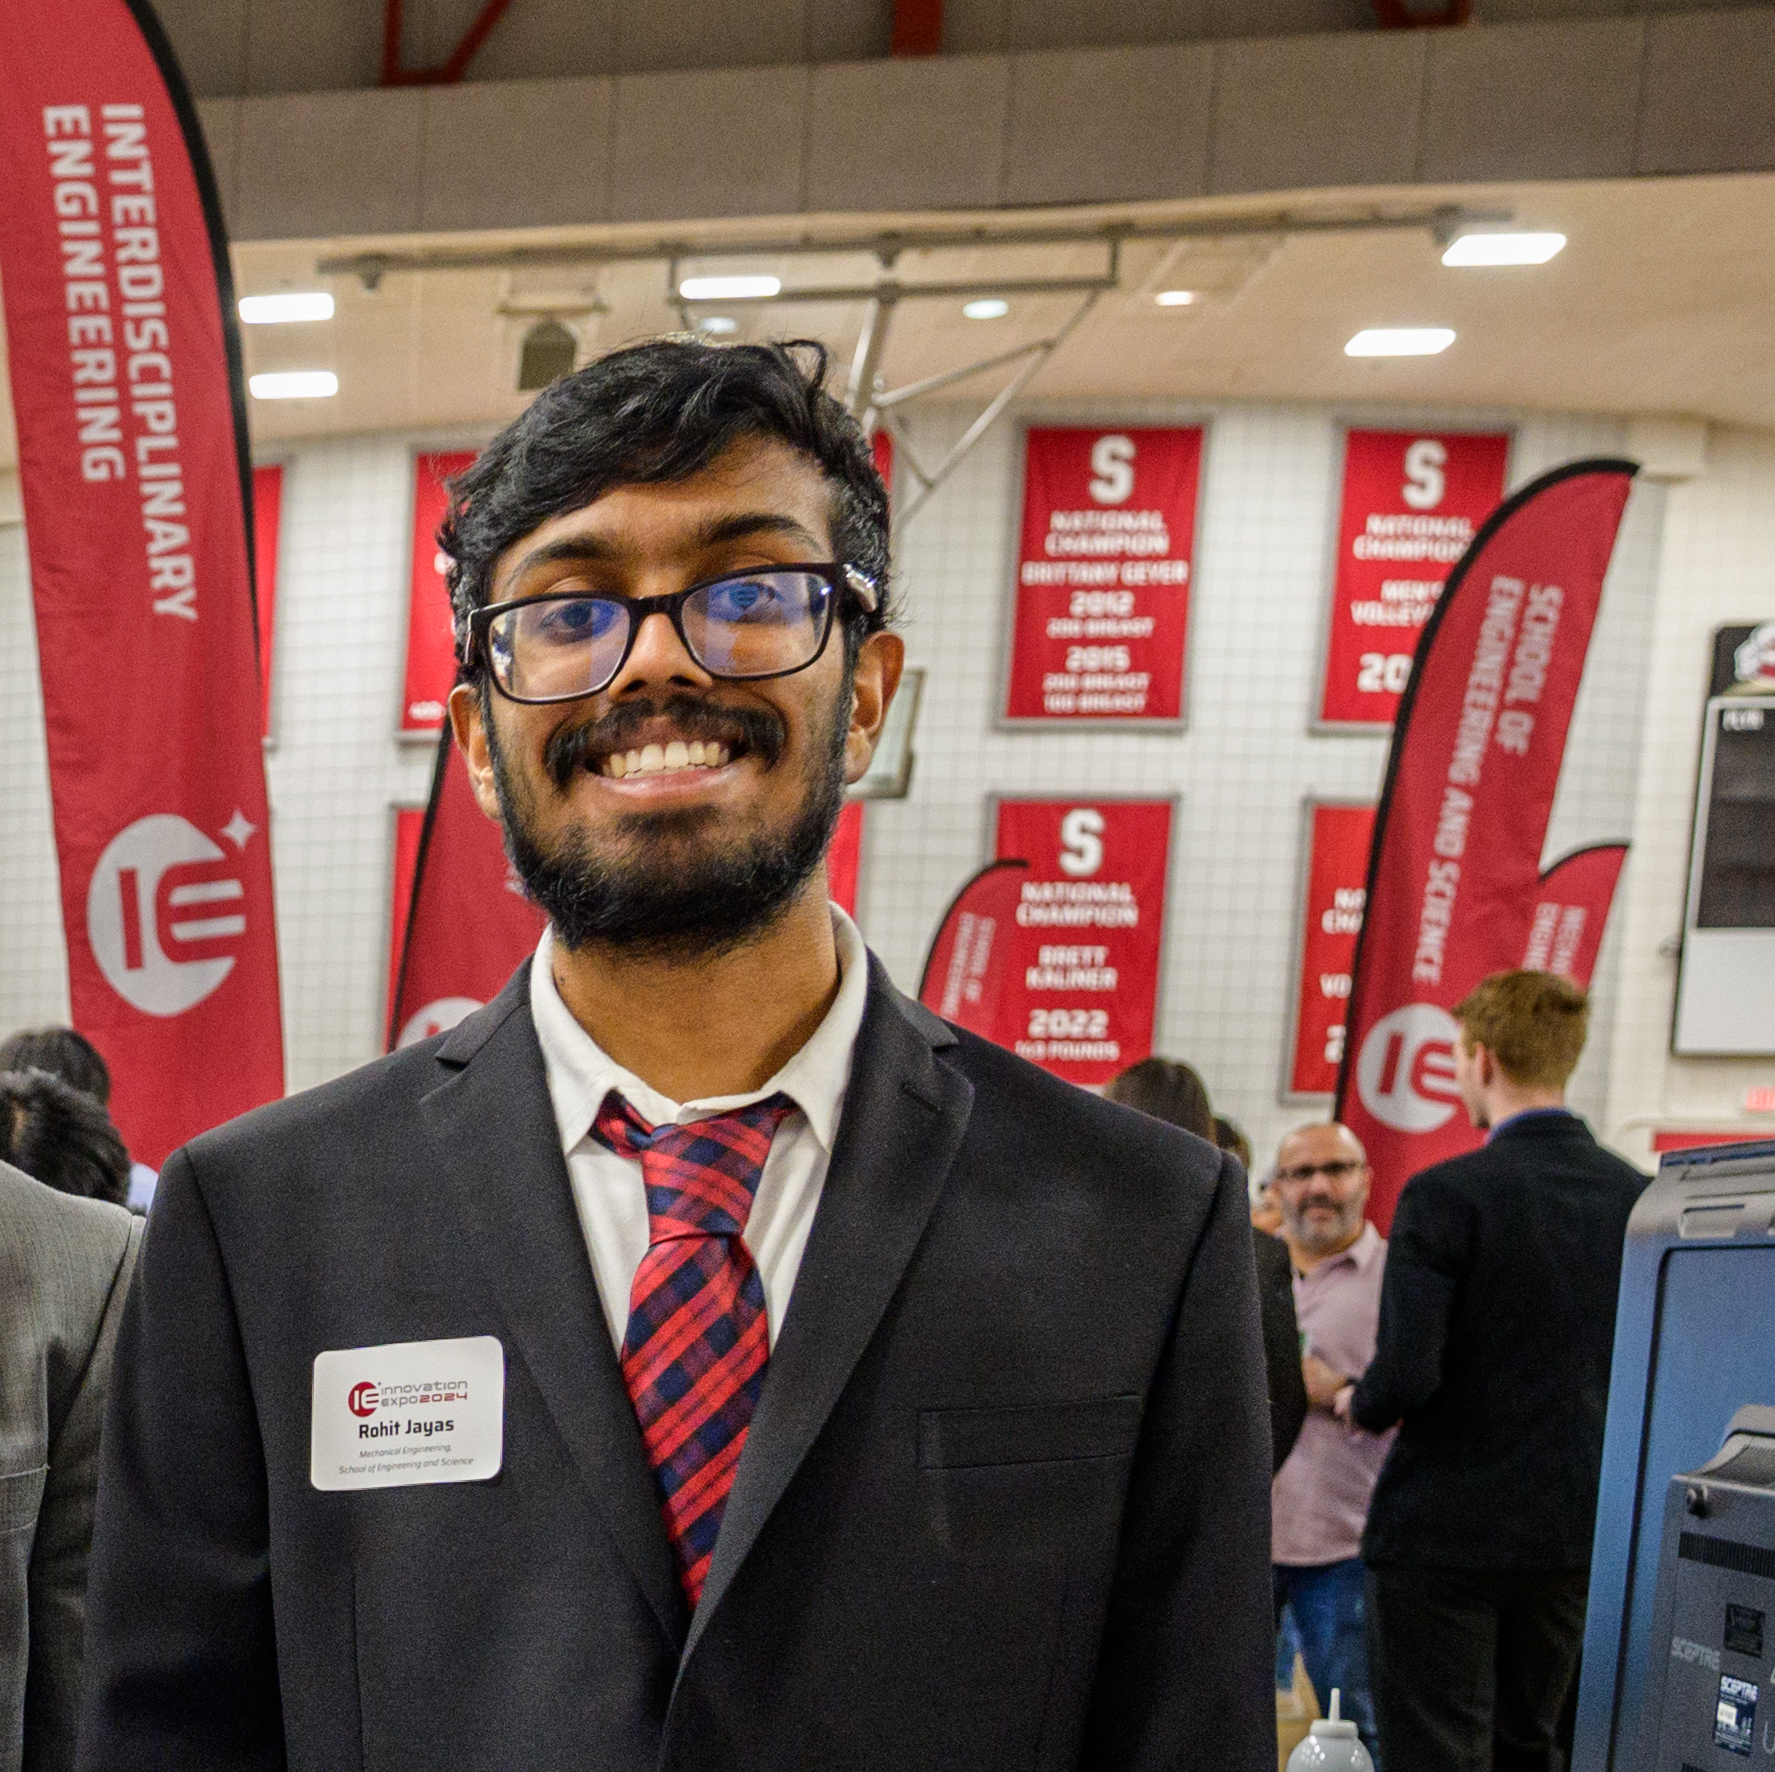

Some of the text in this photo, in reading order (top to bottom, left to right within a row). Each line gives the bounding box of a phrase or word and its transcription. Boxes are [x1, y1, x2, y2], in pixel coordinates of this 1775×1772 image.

[43, 103, 126, 481] ENGINEERING
[100, 103, 198, 622] INTERDISCIPLINARY
[1089, 434, 1138, 505] S
[1402, 438, 1448, 511] S
[1050, 509, 1167, 532] NATIONAL
[1365, 513, 1474, 540] NATIONAL
[1044, 531, 1170, 557] CHAMPION
[1069, 590, 1136, 618] 2012
[1084, 616, 1156, 639] BREAST
[1494, 583, 1564, 758] SCHOOL OF
[1412, 574, 1526, 987] ENGINEERING AND SCIENCE
[1059, 808, 1106, 877] S
[1021, 881, 1137, 904] NATIONAL
[1016, 902, 1139, 928] CHAMPION
[1027, 1008, 1109, 1039] 2022
[380, 1379, 468, 1396] innovation
[380, 1392, 468, 1408] expo2024
[358, 1418, 455, 1440] Rohit Jayas
[338, 1463, 367, 1475] School
[376, 1460, 423, 1473] Engineering
[423, 1458, 440, 1468] and
[441, 1456, 475, 1468] Science
[358, 1446, 401, 1459] Mechanical
